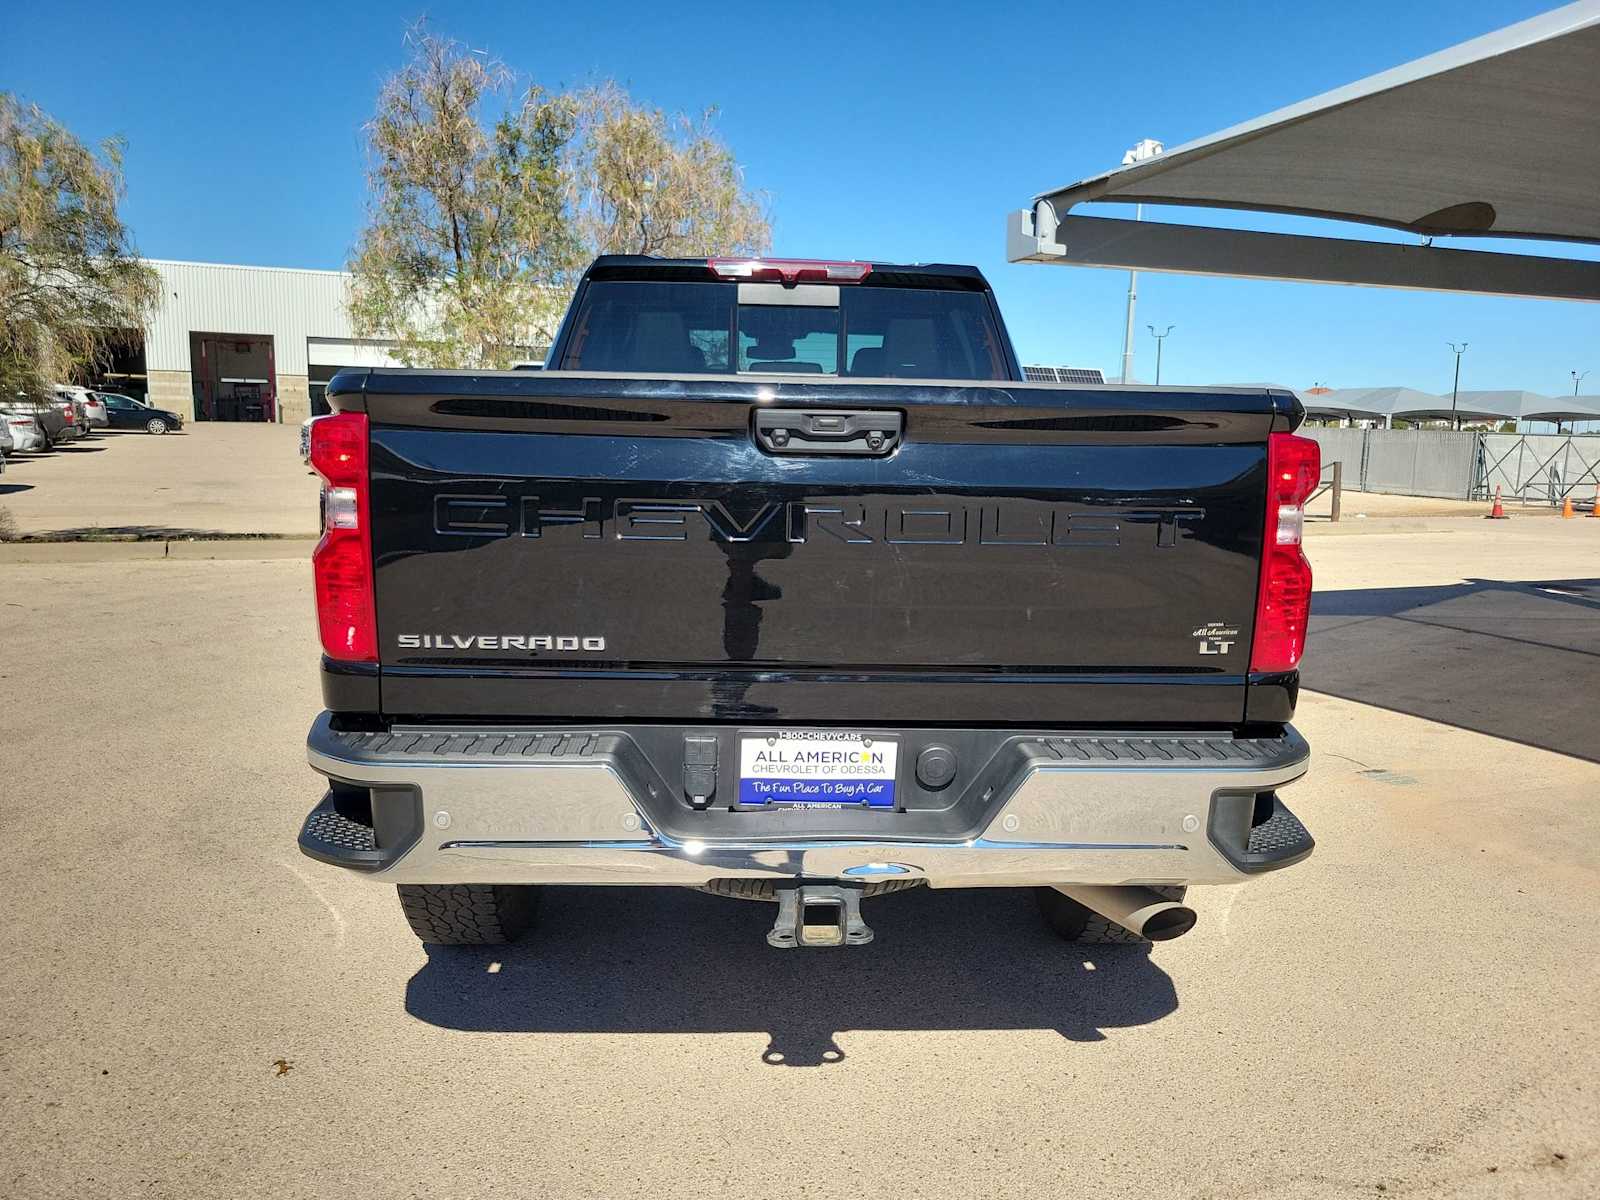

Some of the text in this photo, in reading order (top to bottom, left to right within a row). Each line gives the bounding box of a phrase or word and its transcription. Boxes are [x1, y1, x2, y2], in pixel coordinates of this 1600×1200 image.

[433, 494, 1206, 548] CHEVROLET
[397, 634, 606, 652] SILVERADO
[1199, 641, 1235, 655] LT
[779, 731, 862, 741] 1-800-CHEVYCARS
[755, 751, 883, 764] ALL AMERICN
[752, 764, 886, 774] CHEVROLET OF ODESSA
[752, 781, 884, 796] The Fun Place To Buy A Car
